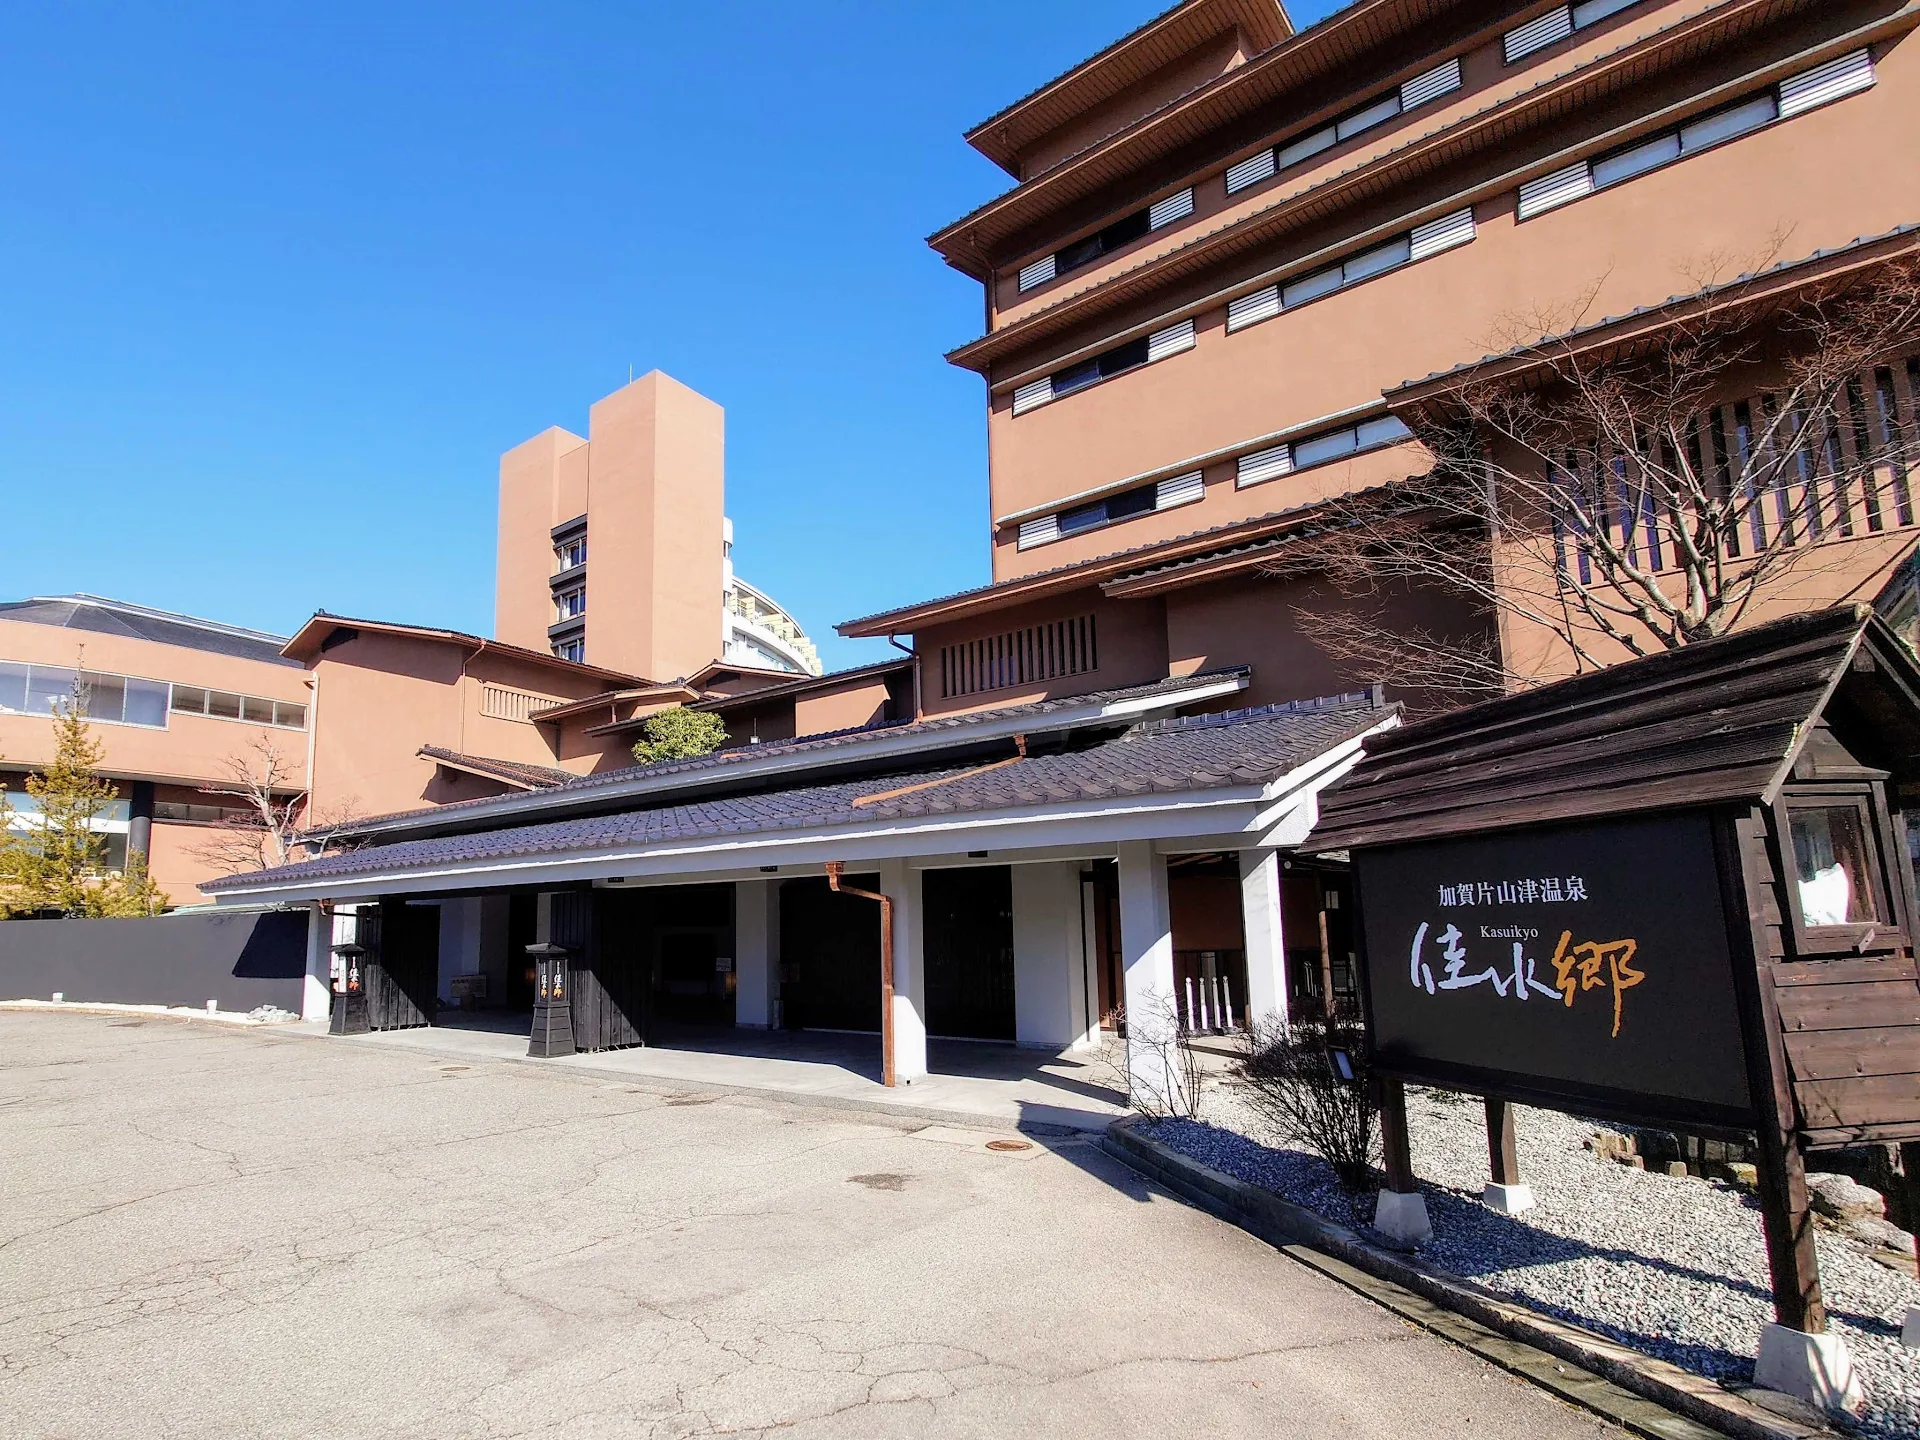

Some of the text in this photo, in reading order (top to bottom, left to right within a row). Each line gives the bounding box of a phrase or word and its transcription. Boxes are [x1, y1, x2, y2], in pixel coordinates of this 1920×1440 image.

[1438, 875, 1588, 906] 加賀片山津温泉
[1480, 925, 1538, 940] Kasuikyo
[1411, 922, 1645, 1037] 佳水郷
